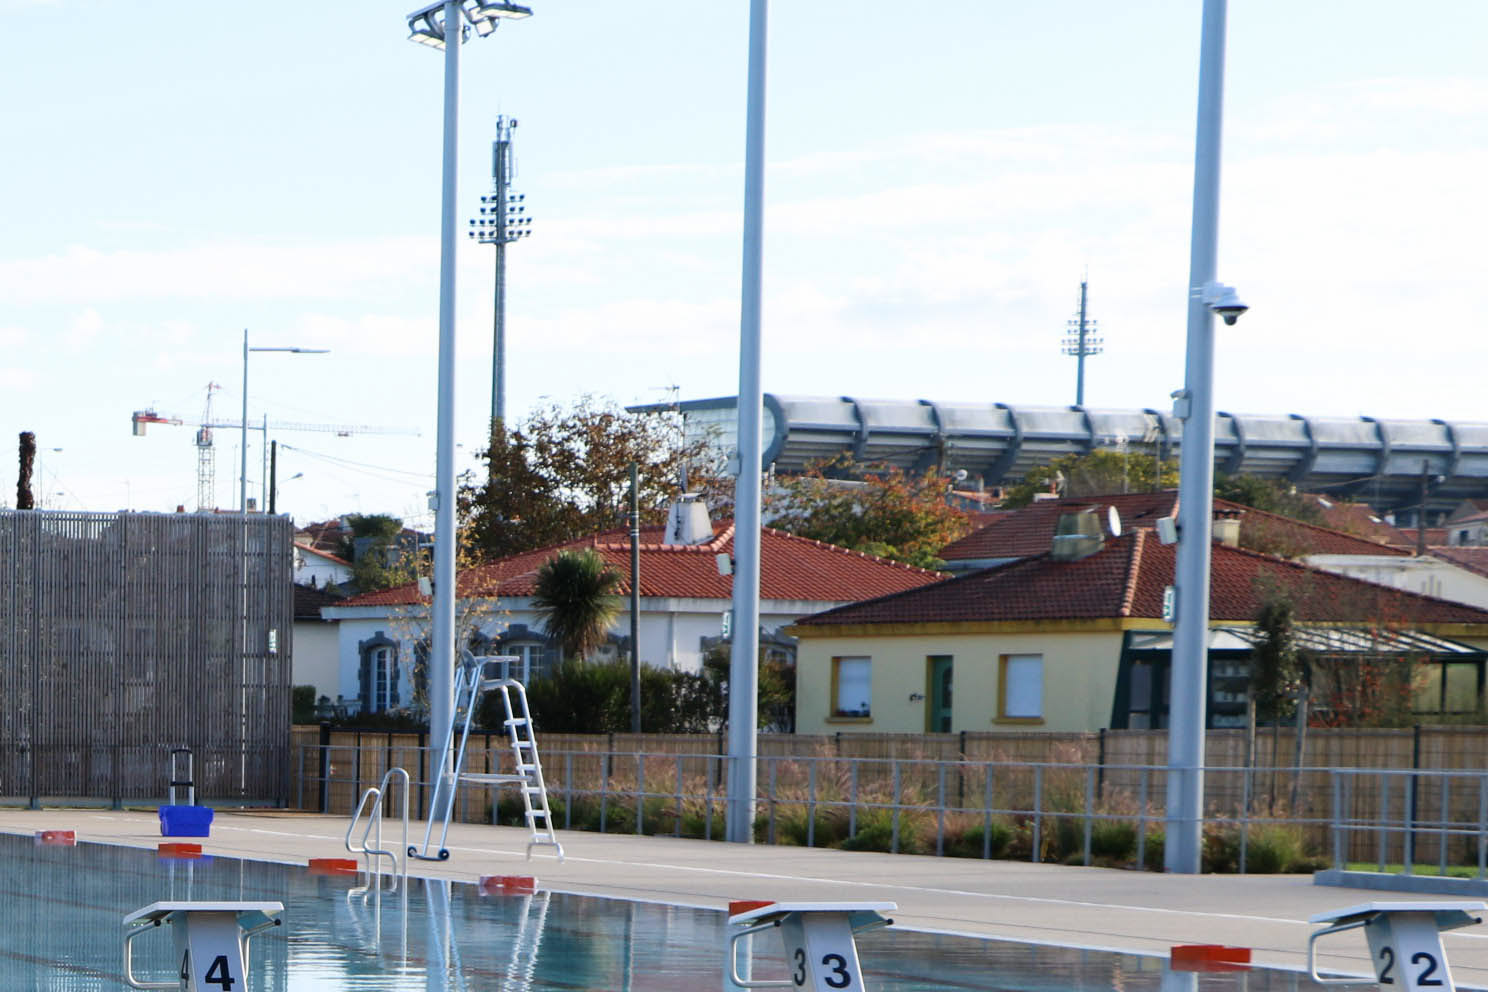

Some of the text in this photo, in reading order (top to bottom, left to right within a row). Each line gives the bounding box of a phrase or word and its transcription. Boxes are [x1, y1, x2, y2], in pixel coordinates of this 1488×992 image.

[180, 949, 189, 989] 4
[205, 955, 235, 991] 4
[794, 948, 806, 986] 3
[822, 953, 851, 989] 3
[1379, 946, 1395, 984] 2
[1411, 951, 1443, 986] 2
